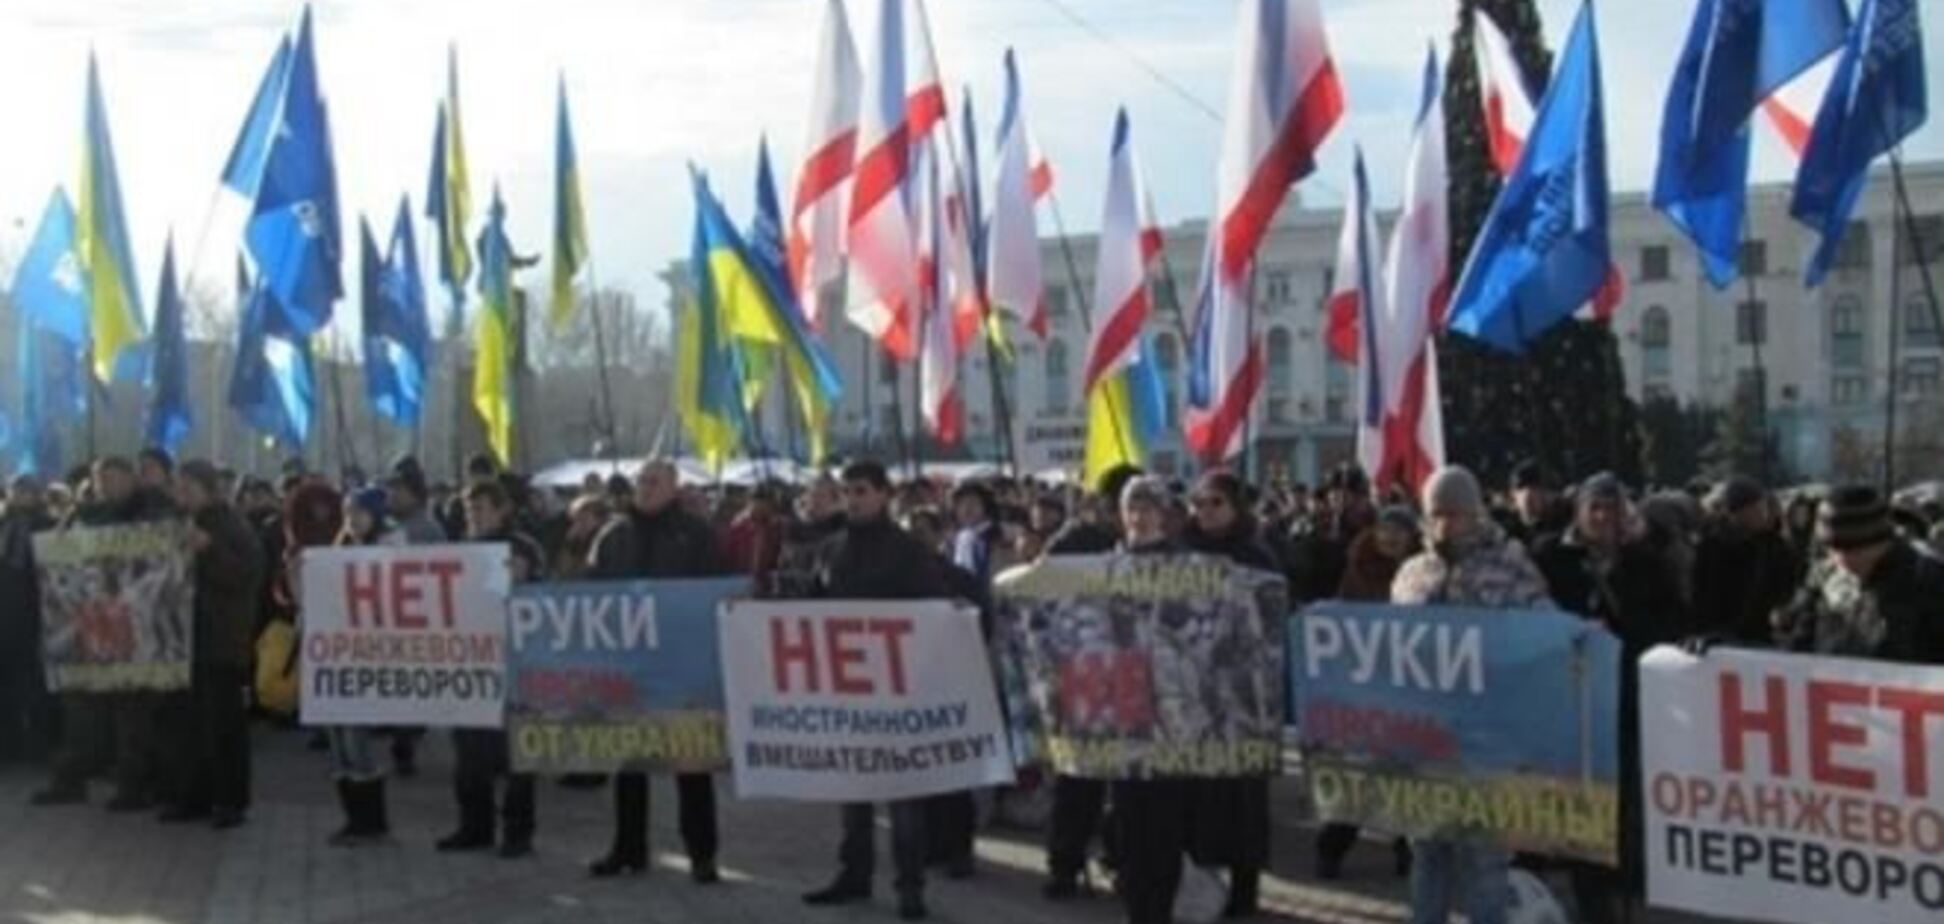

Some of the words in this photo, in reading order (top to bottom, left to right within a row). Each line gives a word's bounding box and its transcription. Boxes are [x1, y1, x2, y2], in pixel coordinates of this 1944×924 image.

[343, 561, 465, 629] НЕТ
[511, 595, 661, 653] РУКИ
[769, 617, 914, 696] НЕТ
[1303, 615, 1485, 693] РУКИ
[519, 723, 565, 758] ОТ
[572, 717, 722, 760] УКРАИН
[752, 703, 968, 737] ИНОСТРАННОМУ
[1719, 671, 1944, 799] НЕТ
[746, 733, 997, 774] ВМЕШАТЕЛЬСТВУ!
[1313, 766, 1367, 816] ОТ
